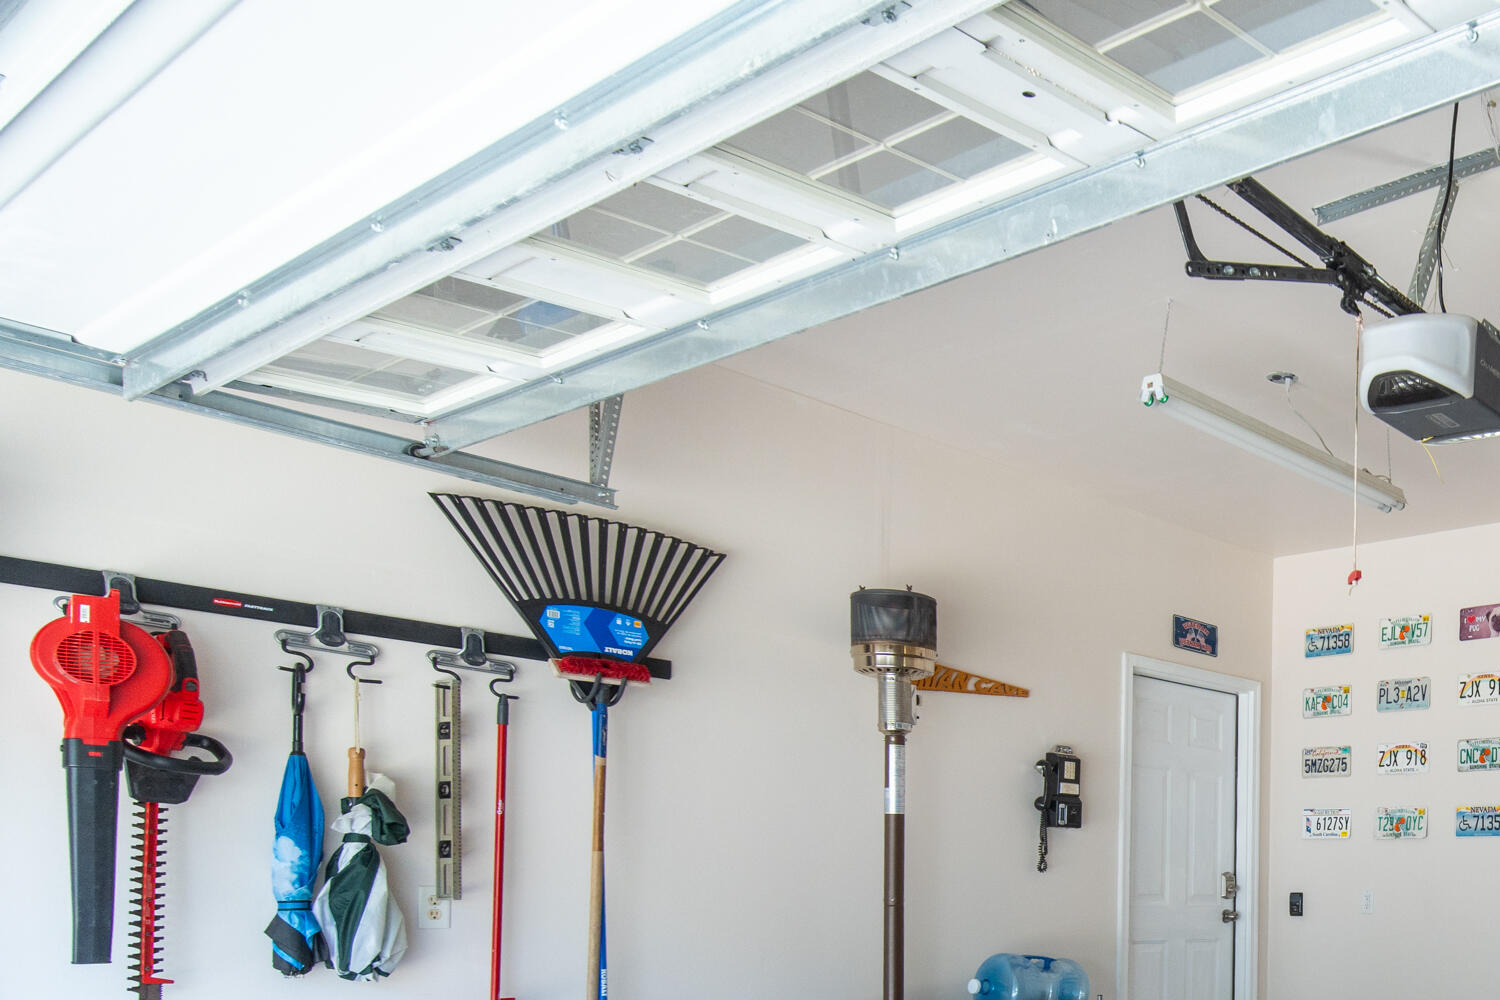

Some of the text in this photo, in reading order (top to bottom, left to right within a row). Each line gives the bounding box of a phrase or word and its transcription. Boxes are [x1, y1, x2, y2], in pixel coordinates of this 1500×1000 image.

[1317, 626, 1341, 635] NEVADA
[1381, 622, 1428, 642] EJL V57
[1320, 632, 1350, 651] 71358
[1378, 684, 1428, 704] PL3 A2V
[1459, 681, 1481, 699] ZJX
[1305, 696, 1321, 711] KAF
[1378, 749, 1428, 768] ZJX 918
[1460, 748, 1478, 764] CNC
[1304, 757, 1348, 774] 5MZG275
[1316, 816, 1350, 831] 6127SY
